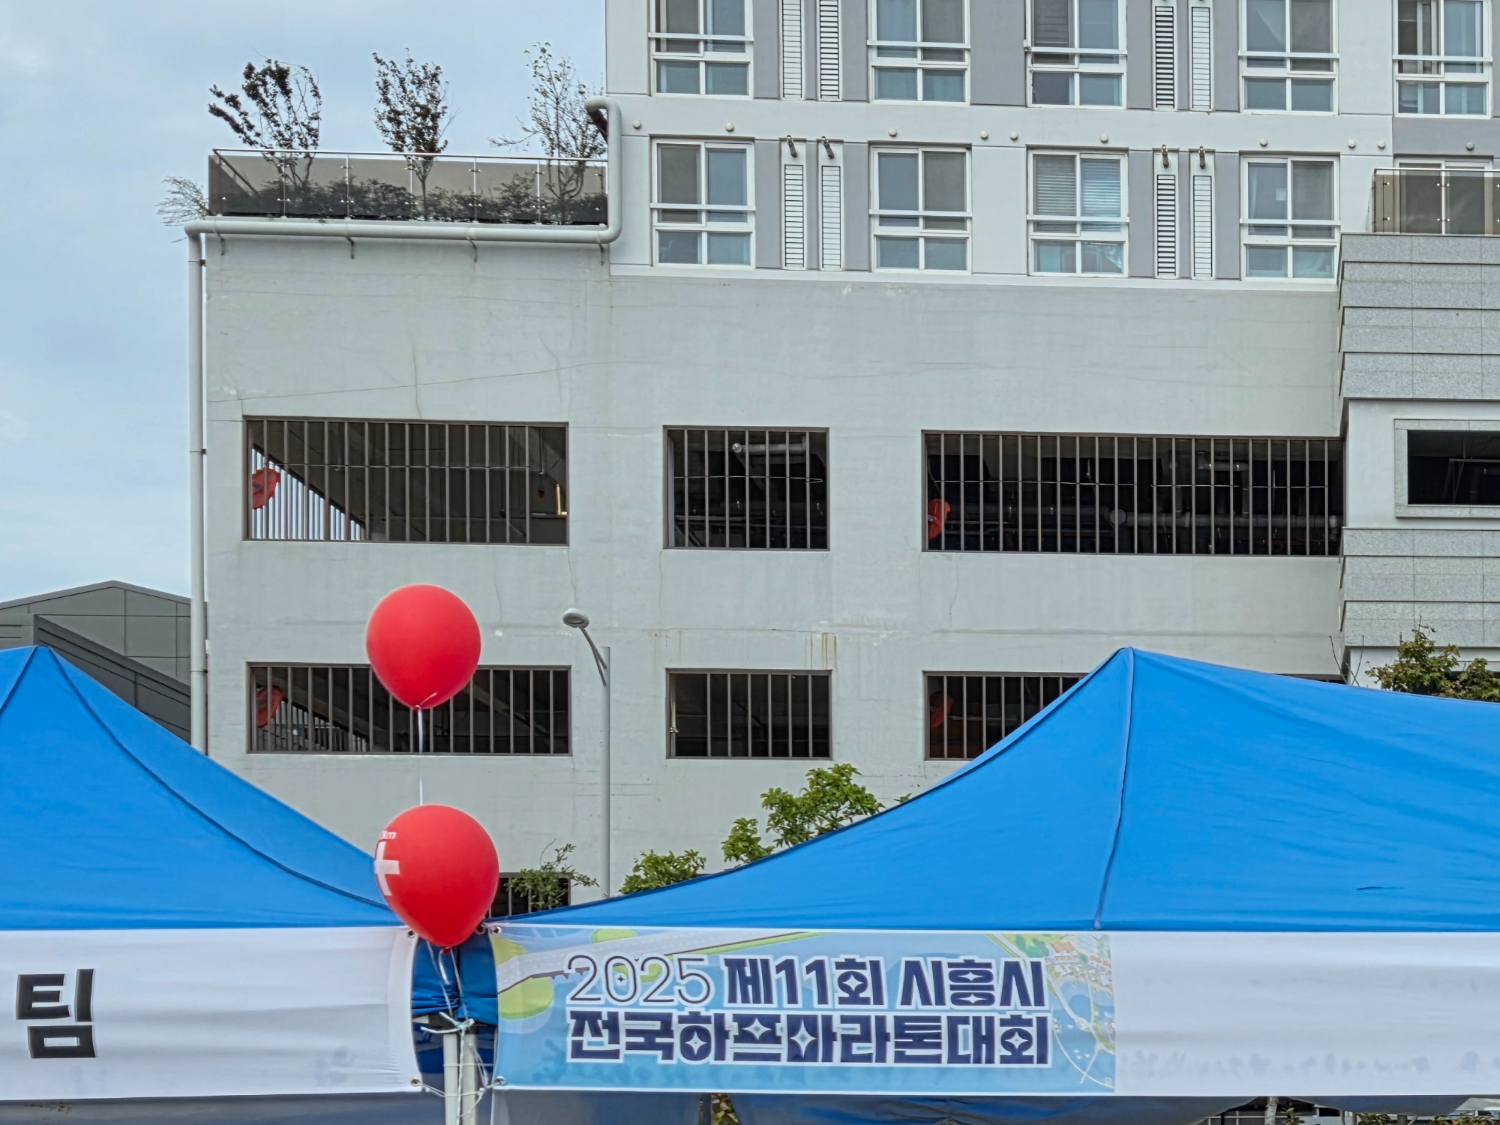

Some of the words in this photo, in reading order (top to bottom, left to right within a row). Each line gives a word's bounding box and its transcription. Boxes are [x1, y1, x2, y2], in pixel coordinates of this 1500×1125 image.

[566, 953, 712, 1005] 2025
[722, 956, 886, 1006] 제11회
[898, 957, 1048, 1008] 시흥시
[16, 967, 96, 1059] 팀
[569, 1009, 1049, 1065] 전국하프마라톤대회
